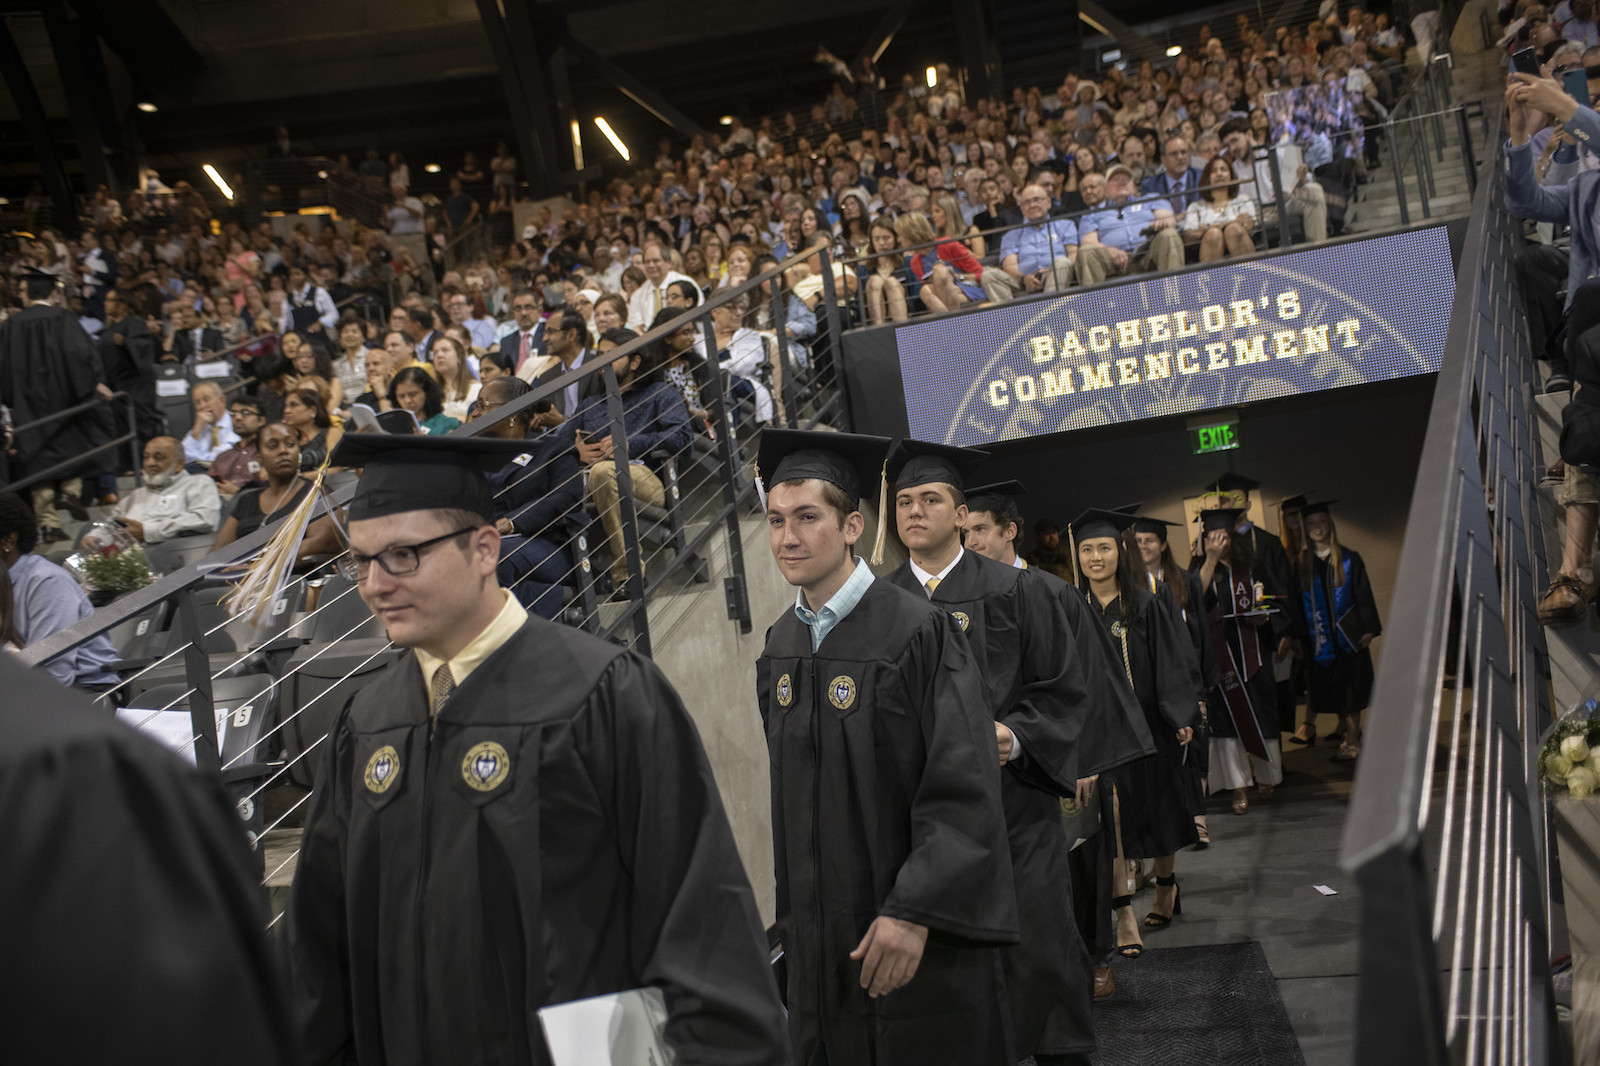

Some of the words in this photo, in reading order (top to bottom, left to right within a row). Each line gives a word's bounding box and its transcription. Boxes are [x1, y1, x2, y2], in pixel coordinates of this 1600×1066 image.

[1029, 289, 1301, 364] BACHELOR'S
[988, 318, 1361, 408] COMMENCEMENT
[1198, 424, 1229, 450] EXIT
[239, 709, 247, 723] 5
[243, 803, 249, 815] 3
